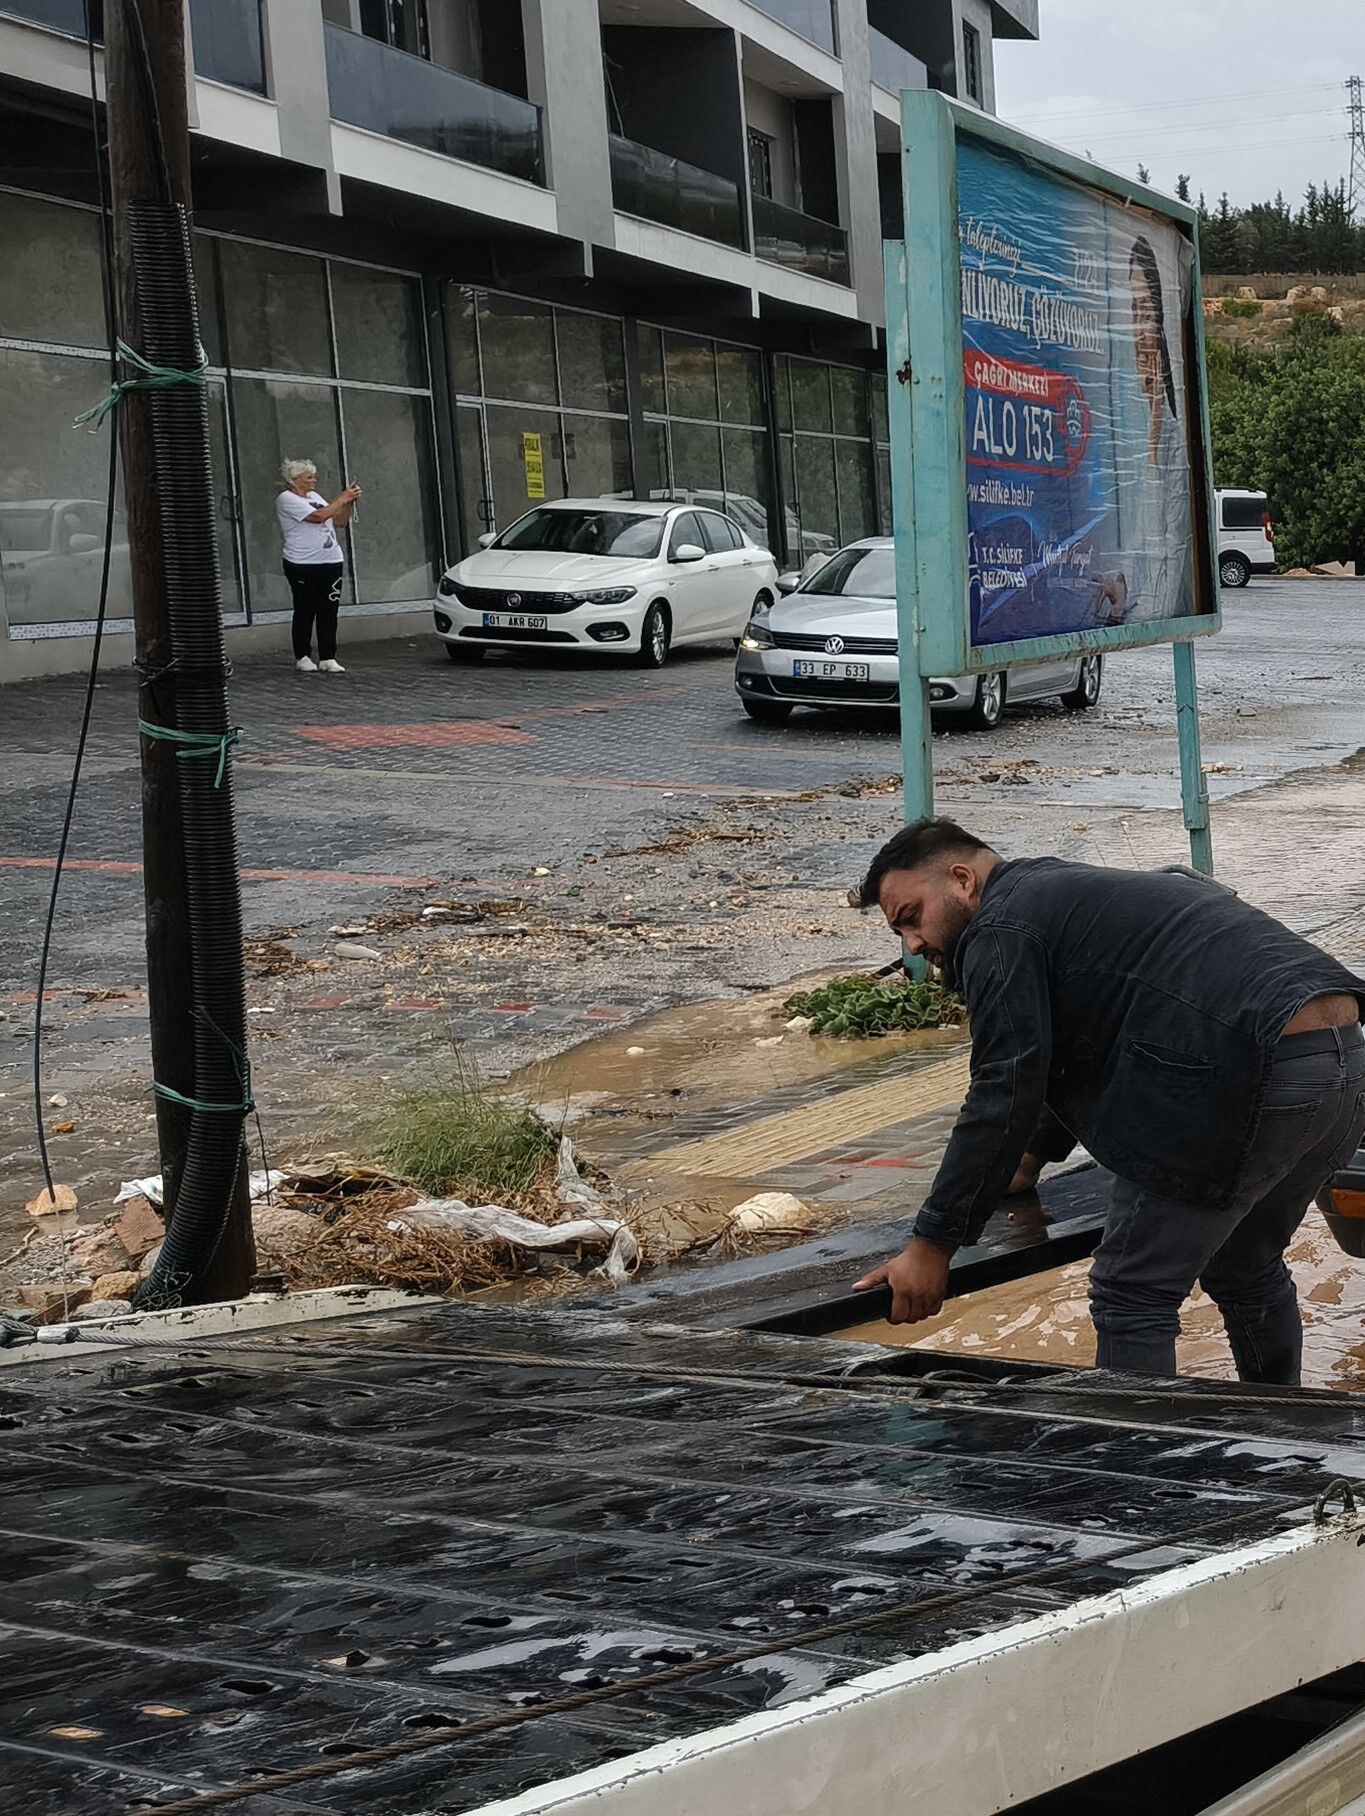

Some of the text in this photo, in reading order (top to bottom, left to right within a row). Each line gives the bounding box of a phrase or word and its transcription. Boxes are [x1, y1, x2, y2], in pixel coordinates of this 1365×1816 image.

[1008, 369, 1049, 397] MERKEZİ
[972, 395, 1054, 462] ALO 153
[489, 615, 545, 628] 01 AKR 607
[801, 662, 866, 677] 33 EP 633
